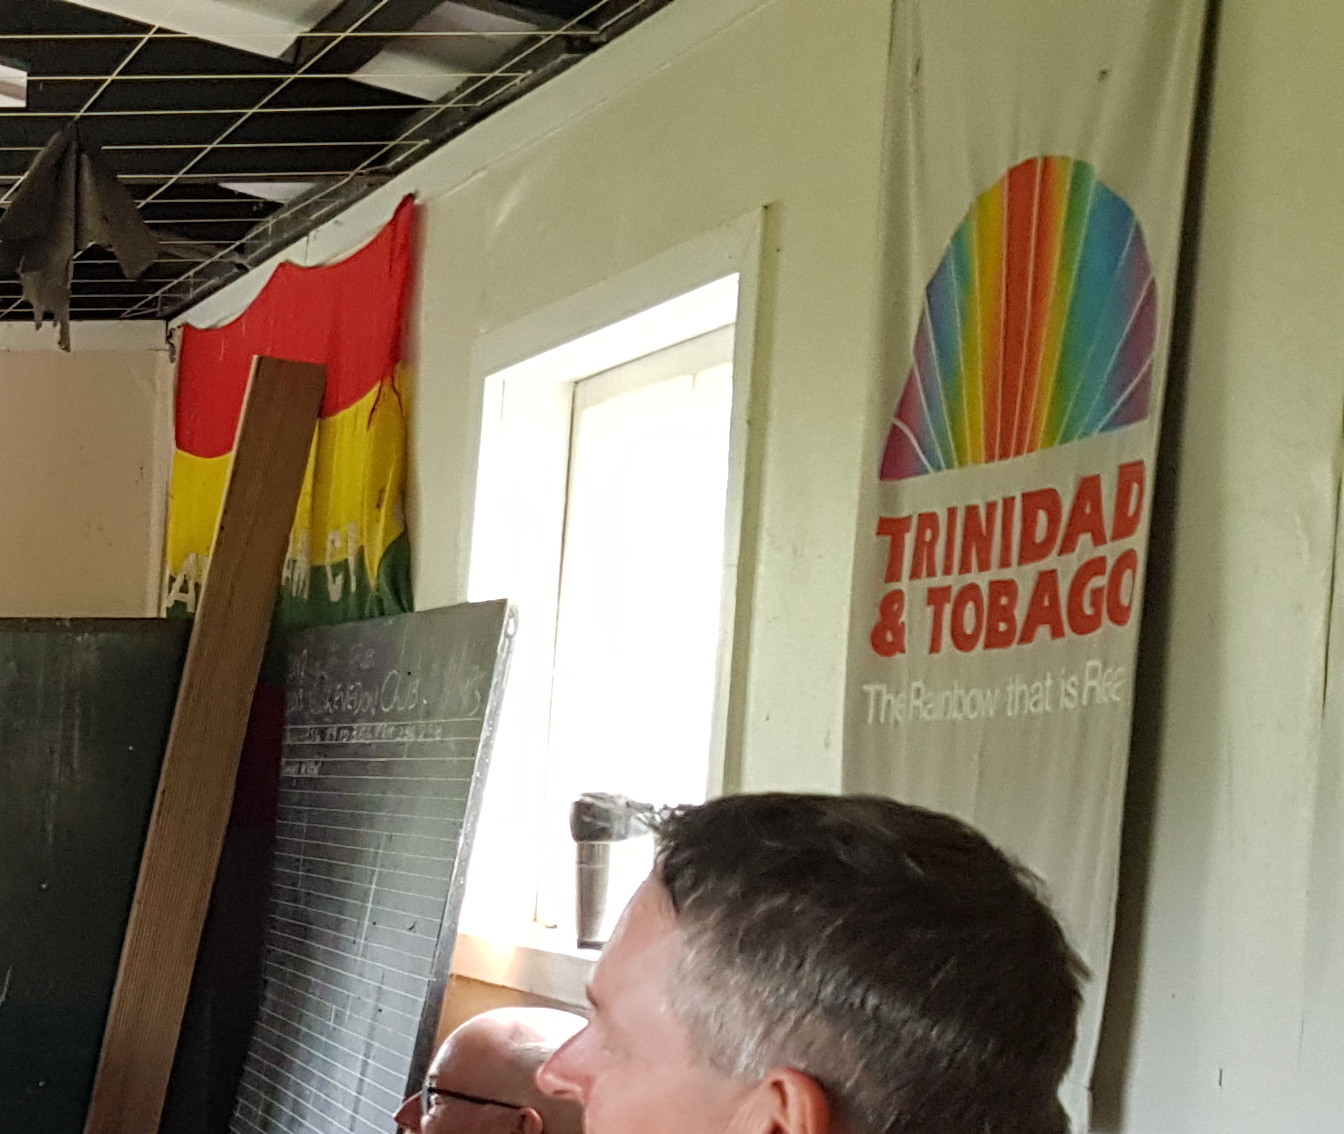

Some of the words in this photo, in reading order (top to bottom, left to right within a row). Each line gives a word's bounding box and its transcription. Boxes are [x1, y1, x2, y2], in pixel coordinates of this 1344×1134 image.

[876, 459, 1146, 584] TRINIDAD
[870, 588, 906, 657] &
[926, 548, 1138, 655] TOBAGO
[862, 682, 908, 724] The
[911, 679, 1002, 720] Ranbow
[1006, 671, 1054, 717] that
[1059, 664, 1079, 710] is
